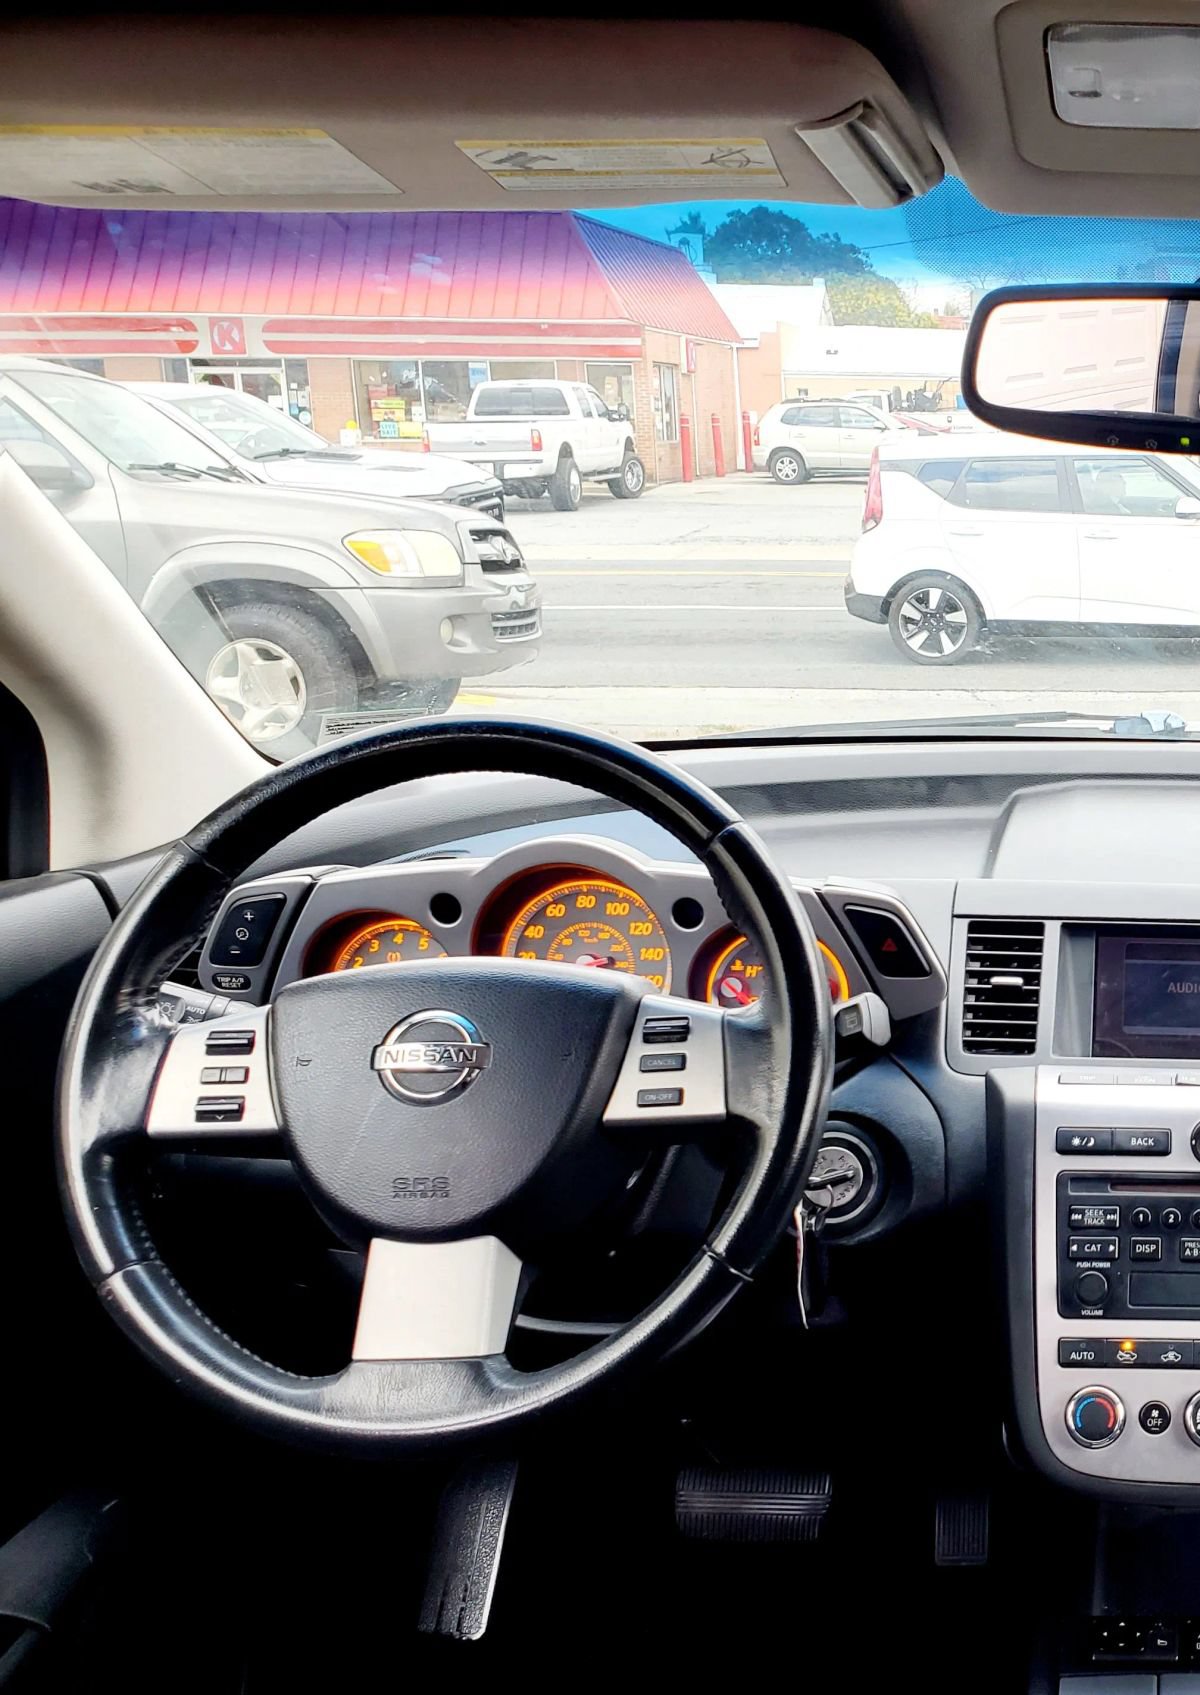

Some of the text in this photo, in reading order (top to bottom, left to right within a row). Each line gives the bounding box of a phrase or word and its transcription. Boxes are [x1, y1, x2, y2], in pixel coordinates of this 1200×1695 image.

[576, 895, 596, 909] 80
[546, 903, 566, 918] 60
[605, 902, 630, 917] 100
[524, 925, 545, 939] 40
[629, 921, 653, 936] 120
[393, 932, 404, 945] 4
[418, 937, 429, 950] 5
[369, 939, 380, 952] 3
[639, 947, 664, 961] 140
[353, 957, 364, 968] 2
[744, 965, 756, 978] H
[186, 1005, 206, 1015] AUTO
[384, 1048, 477, 1064] NISSAN
[1131, 1137, 1154, 1146] BACK
[393, 1177, 449, 1190] SRS
[1139, 1214, 1143, 1222] 1
[1168, 1215, 1174, 1223] 2
[1084, 1243, 1102, 1252] CAT
[1135, 1244, 1156, 1253] DISP
[1070, 1352, 1095, 1360] AUTO
[1147, 1418, 1163, 1427] OFF
